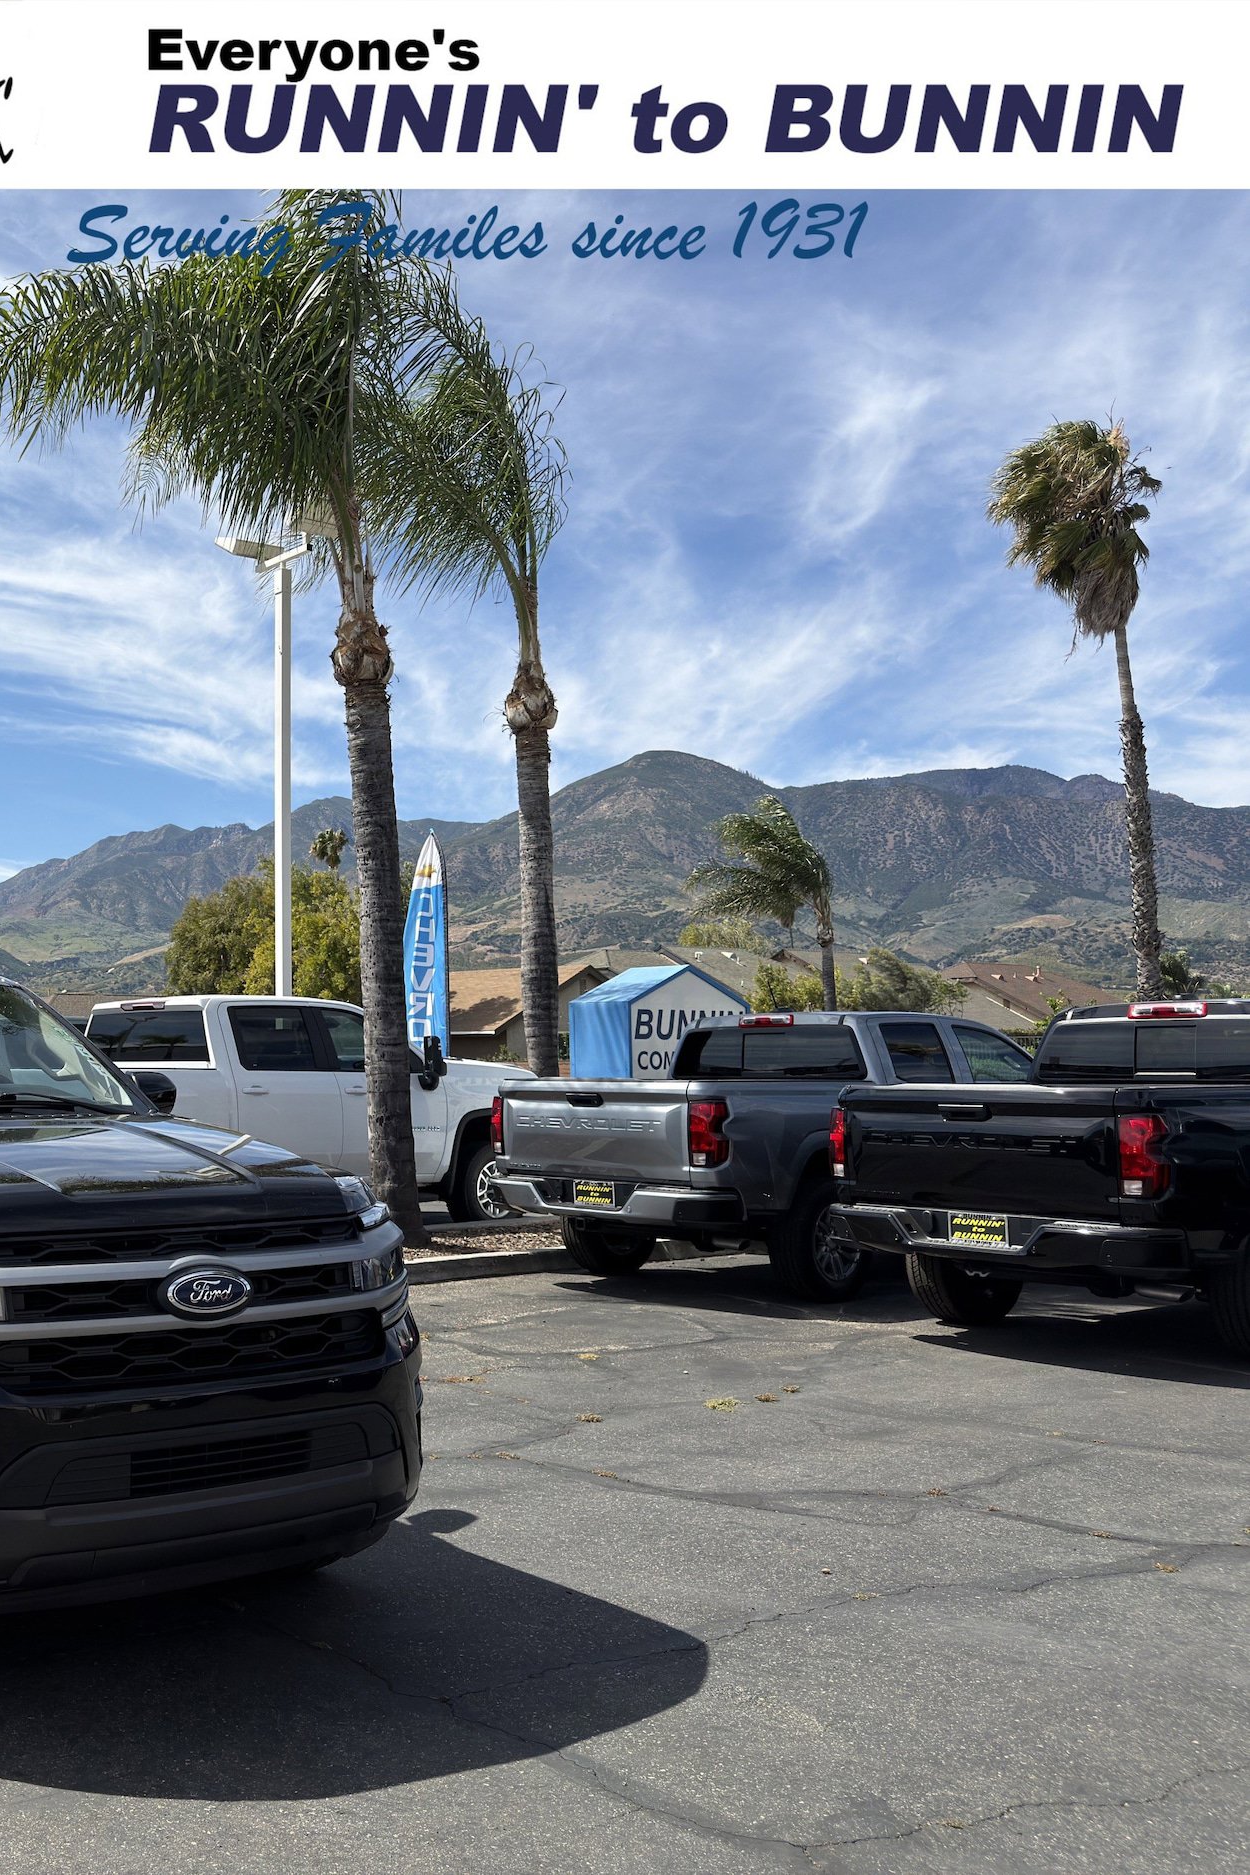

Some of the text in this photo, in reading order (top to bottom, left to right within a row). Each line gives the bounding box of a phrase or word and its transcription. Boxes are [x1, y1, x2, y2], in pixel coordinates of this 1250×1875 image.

[515, 1115, 662, 1133] CHEVROLET
[577, 1195, 611, 1204] BUNNIN
[952, 1217, 1005, 1227] RUNNIN'
[953, 1231, 1003, 1241] BUNNIN
[190, 1280, 232, 1303] Ford
